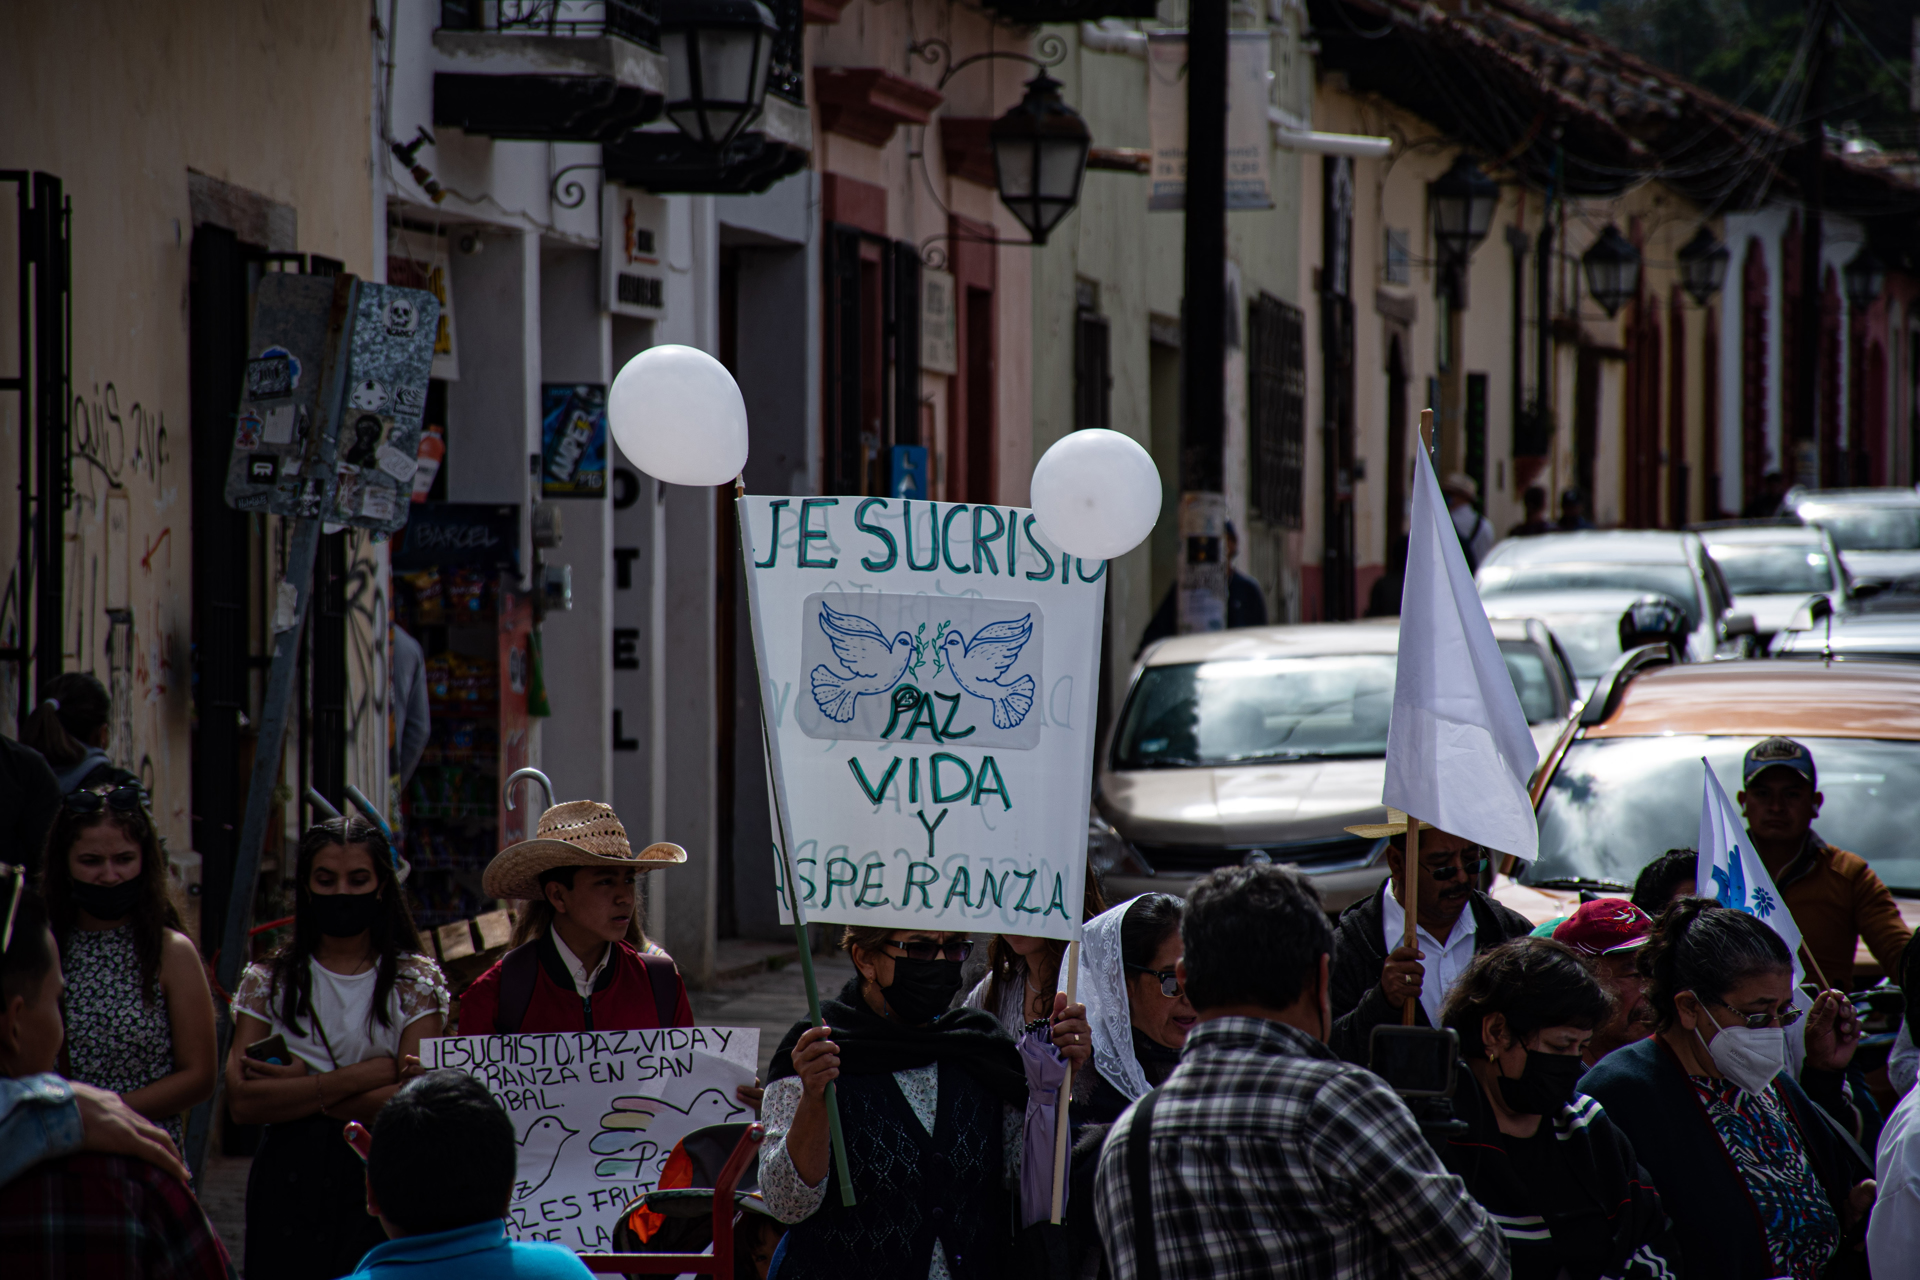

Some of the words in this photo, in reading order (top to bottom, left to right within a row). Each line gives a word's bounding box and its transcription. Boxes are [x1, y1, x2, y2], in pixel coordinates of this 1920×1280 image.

[414, 522, 500, 549] BARCEL
[613, 468, 640, 750] OTEL
[880, 682, 977, 743] PAZ
[847, 752, 1012, 812] VIDA
[917, 808, 948, 857] Y
[796, 857, 1072, 920] SPERANZA
[589, 1060, 624, 1083] EN
[636, 1053, 693, 1081] SAN
[503, 1208, 540, 1236] AZ
[540, 1196, 582, 1222] ES
[577, 1225, 612, 1248] LA
